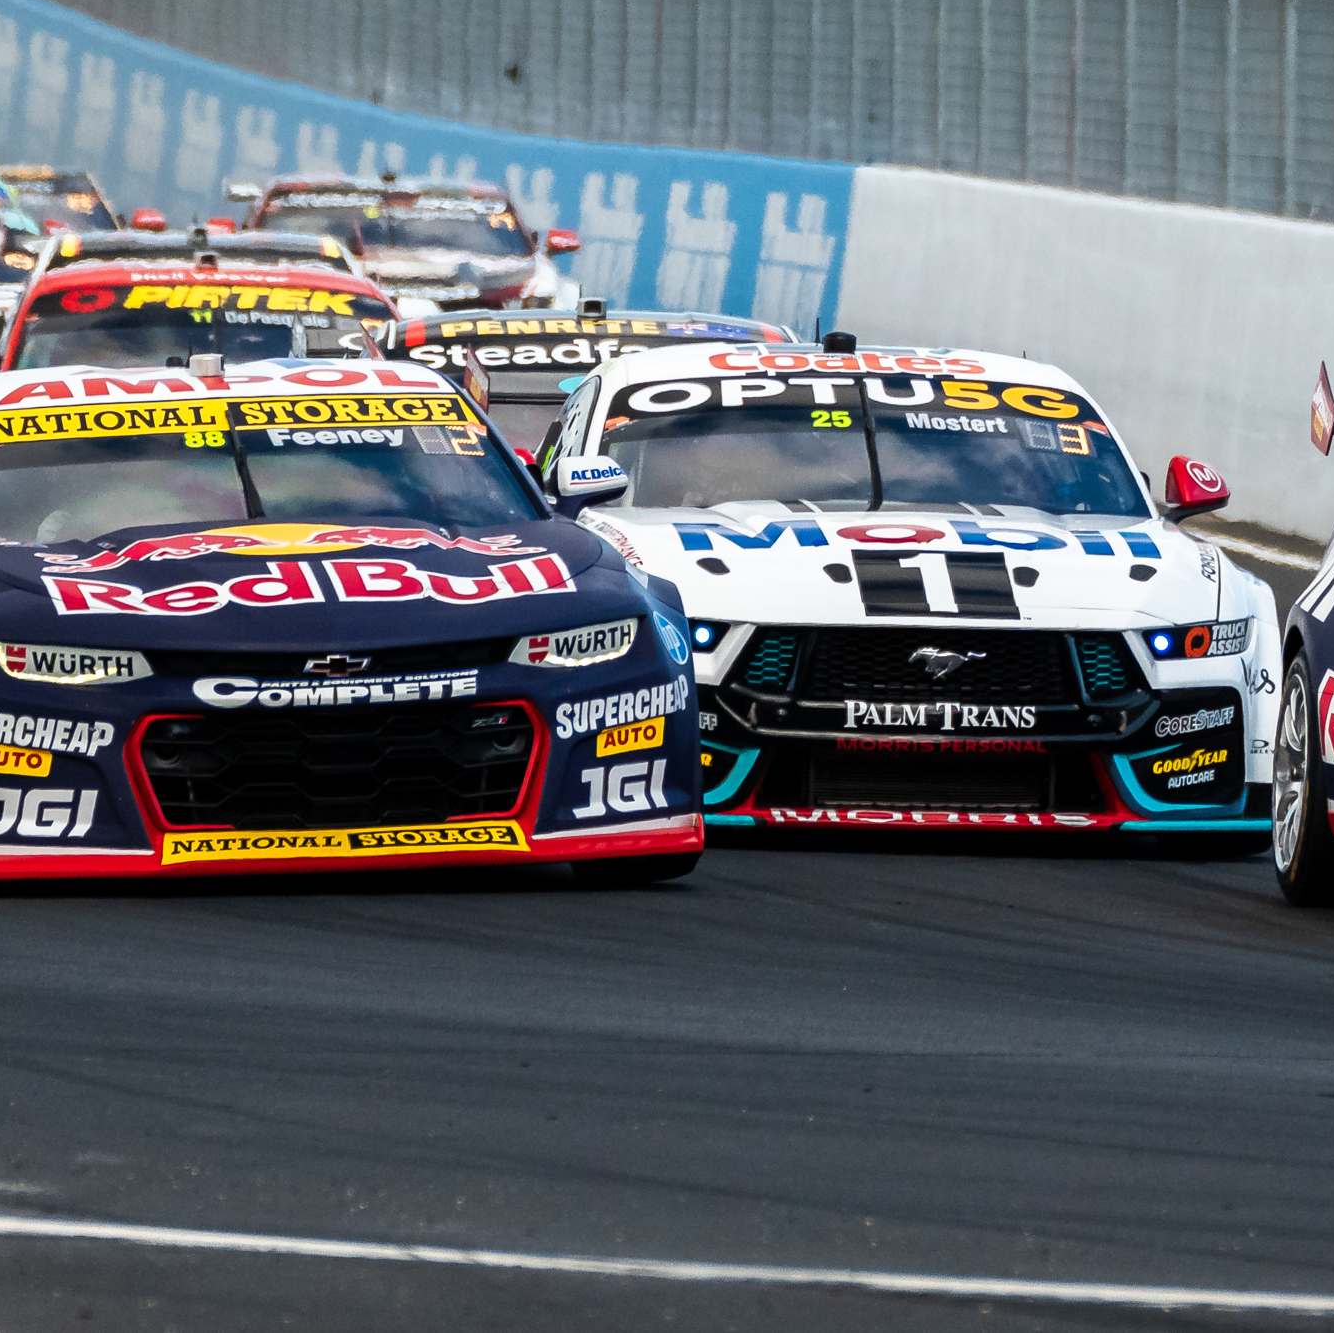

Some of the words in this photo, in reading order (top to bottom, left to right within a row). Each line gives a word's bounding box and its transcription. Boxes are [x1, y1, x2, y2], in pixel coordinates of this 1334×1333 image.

[123, 285, 356, 316] PIRTEK
[440, 319, 661, 338] PENRITE
[244, 398, 458, 426] STORAGE
[811, 410, 852, 428] 25
[905, 413, 1008, 434] Mostert
[184, 431, 226, 449] 88
[267, 426, 404, 449] Feeney
[672, 520, 1162, 560] Mobil
[42, 560, 325, 616] Red
[323, 553, 578, 606] Bull
[899, 552, 959, 613] 1
[1211, 621, 1246, 641] TRUCK
[405, 668, 479, 682] SOLUTIONS
[556, 674, 689, 740] SUPERCHEAP
[844, 700, 928, 728] PALM
[935, 702, 1037, 730] TRANS
[603, 724, 657, 749] AUTO
[939, 739, 1047, 754] PERSONAL
[1152, 748, 1228, 775] GOODYEAR
[573, 759, 669, 819] JGI
[1167, 769, 1216, 790] AUTOCARE
[170, 834, 344, 855] NATIONAL
[360, 826, 512, 847] STORAGE
